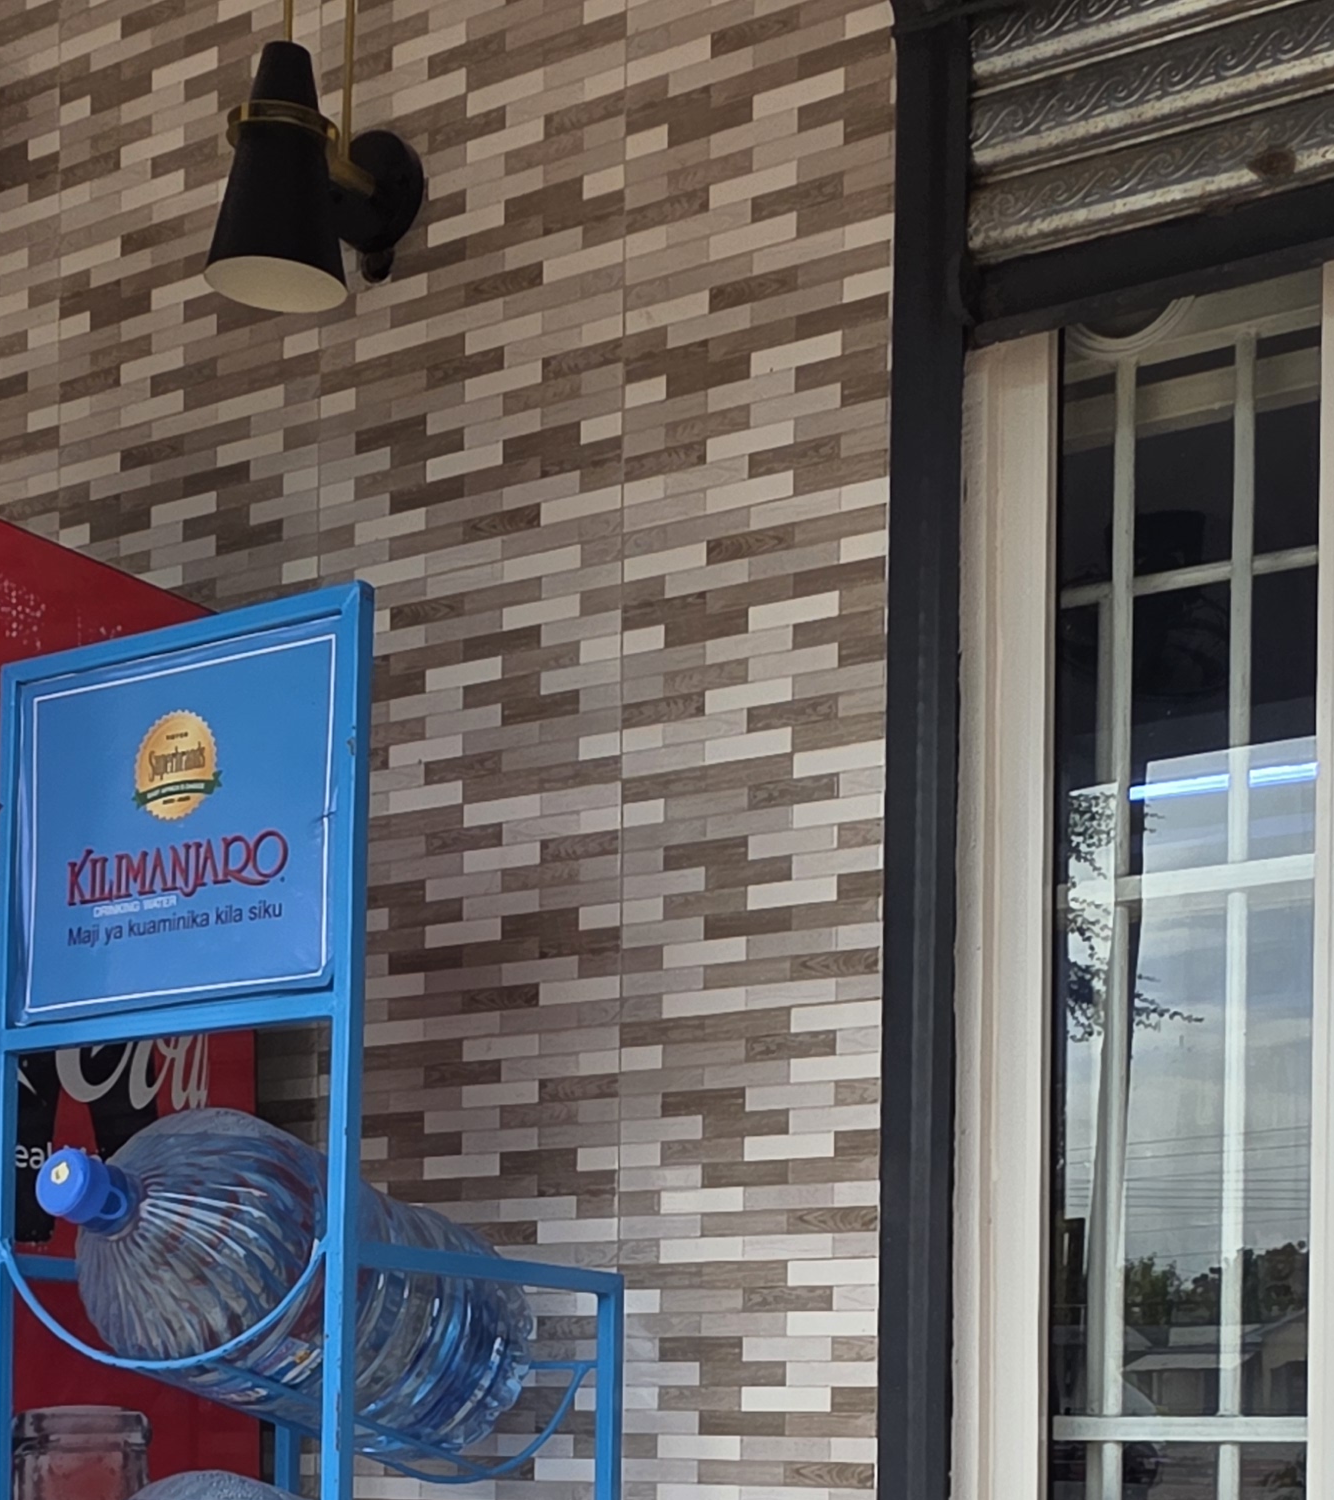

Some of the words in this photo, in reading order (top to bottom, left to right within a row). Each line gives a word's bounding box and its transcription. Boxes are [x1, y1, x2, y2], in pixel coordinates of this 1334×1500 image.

[67, 829, 289, 906] KILIMANJARO
[68, 925, 100, 947] Maji
[104, 924, 123, 945] ya
[128, 910, 210, 937] kuaminika
[215, 903, 243, 925] kila
[248, 900, 283, 920] siku
[93, 900, 141, 918] DRINKING
[143, 895, 177, 912] WATER
